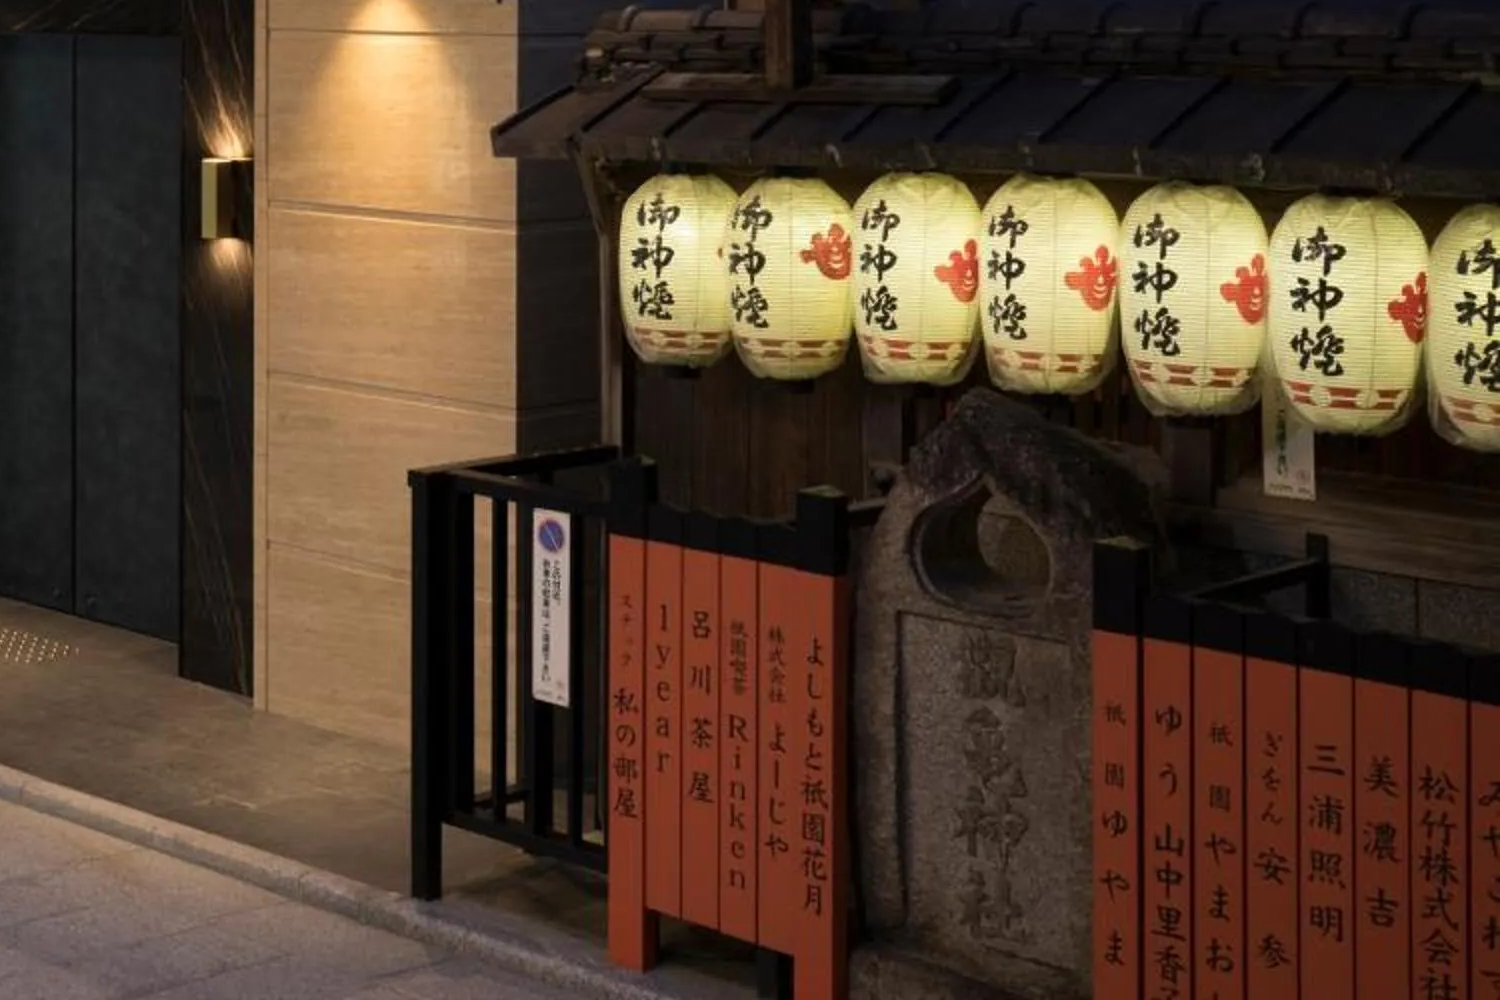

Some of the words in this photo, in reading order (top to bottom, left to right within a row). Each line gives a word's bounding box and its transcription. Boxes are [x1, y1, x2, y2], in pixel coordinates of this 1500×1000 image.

[613, 687, 639, 819] 私の部屋
[728, 714, 749, 890] Rinken
[764, 722, 790, 862] よーじや
[800, 637, 830, 917] よしもと祇園花月
[1306, 744, 1348, 944] 三浦照明
[1361, 755, 1401, 930] 美濃吉
[1202, 722, 1238, 1000] 祇園やまお
[1417, 763, 1462, 1000] 松竹株式会社
